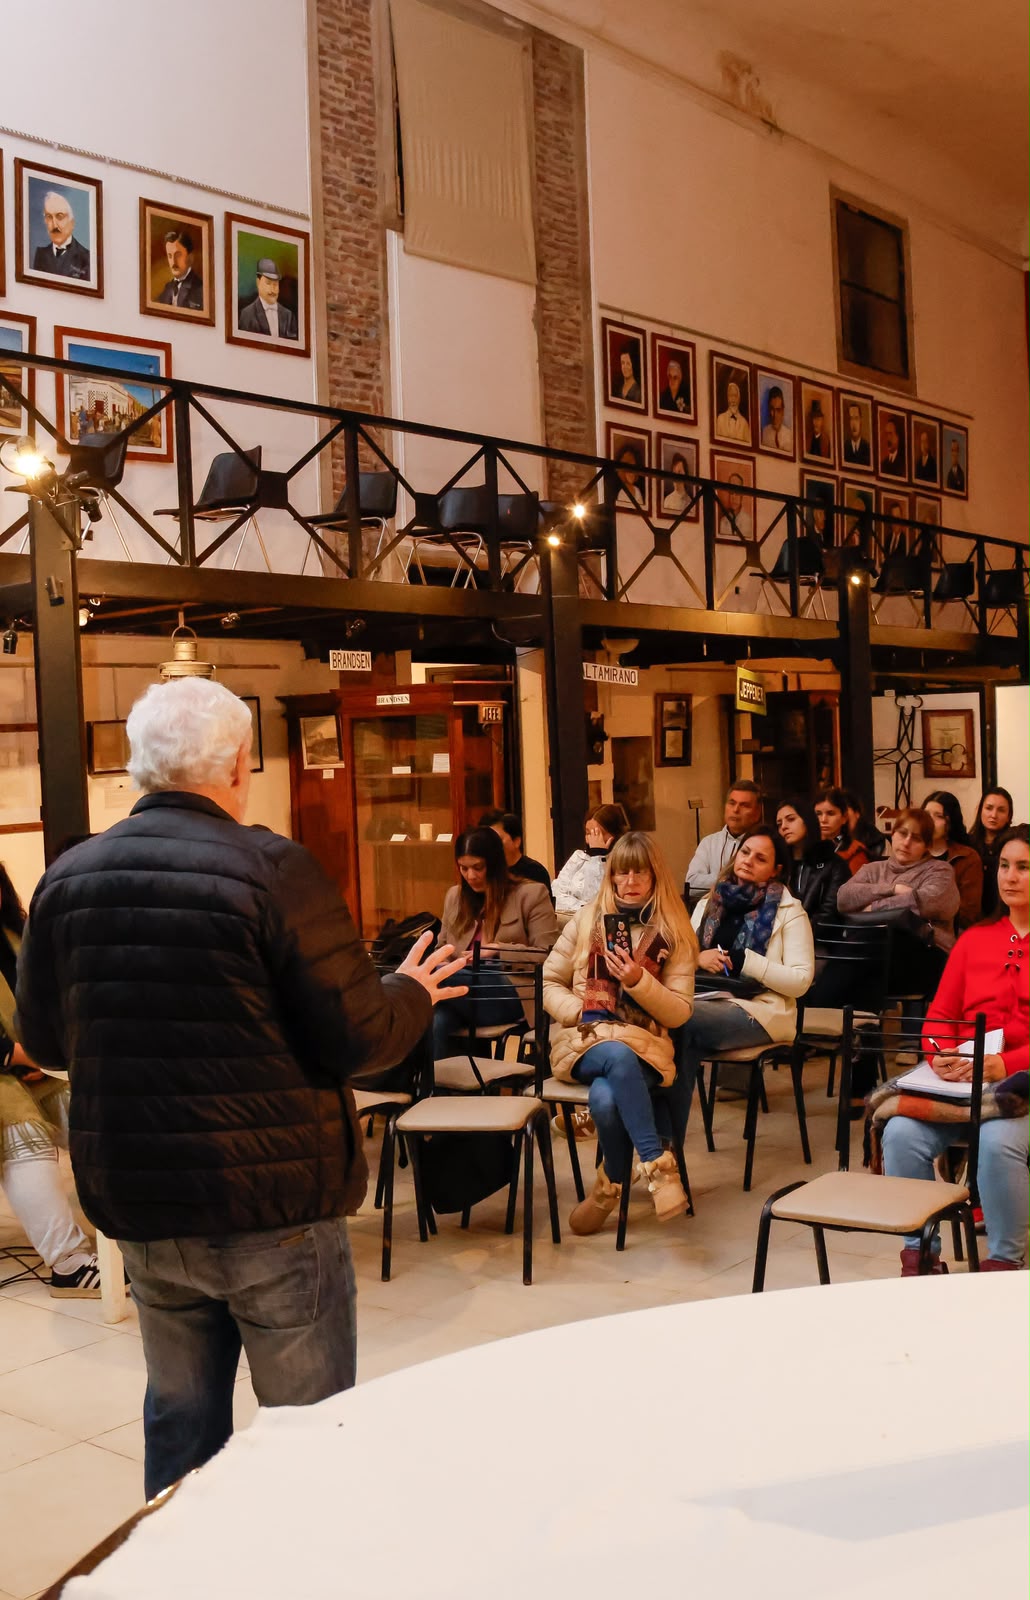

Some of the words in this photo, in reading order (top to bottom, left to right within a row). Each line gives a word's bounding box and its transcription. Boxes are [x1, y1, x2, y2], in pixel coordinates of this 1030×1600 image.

[332, 652, 370, 669] BRANDSEN
[583, 663, 637, 684] LTAMIRANO
[377, 695, 409, 704] BRANDSEN
[483, 706, 500, 721] JEFE
